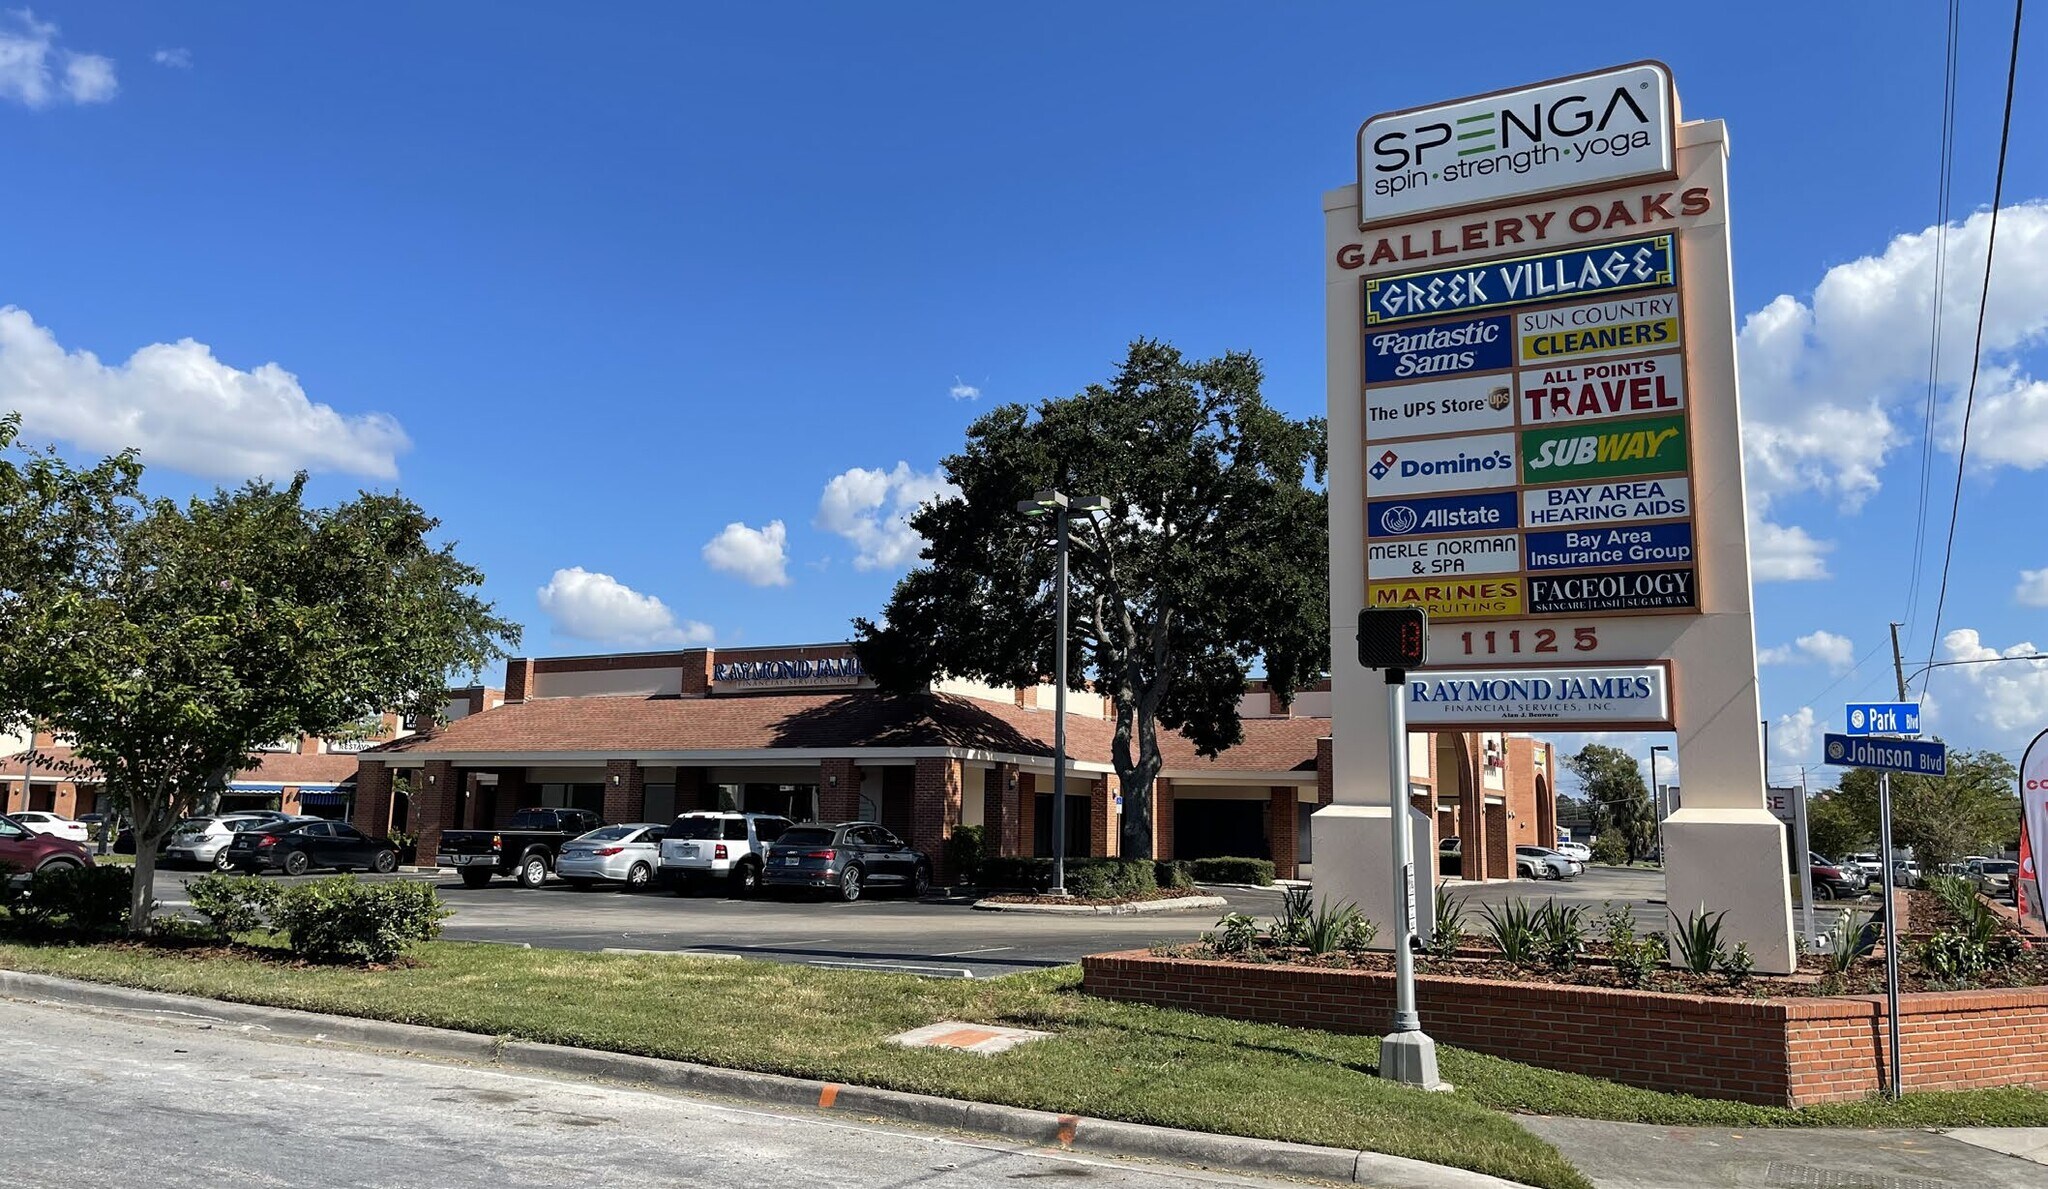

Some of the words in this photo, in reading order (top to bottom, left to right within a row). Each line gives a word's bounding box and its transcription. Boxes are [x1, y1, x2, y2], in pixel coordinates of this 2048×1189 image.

[1373, 86, 1650, 172] SPENGA
[1375, 167, 1428, 197] spin
[1443, 143, 1560, 182] strength
[1573, 130, 1651, 163] yoga
[1337, 211, 1556, 270] GALLERY
[1568, 187, 1711, 234] OAKS
[1379, 270, 1488, 316] GREEK
[1500, 247, 1654, 299] VILLAGE
[1524, 311, 1565, 332] SUN
[1572, 297, 1674, 326] COUNTRY
[1372, 320, 1500, 356] Fantastic
[1532, 321, 1668, 356] CLEANERS
[1394, 351, 1475, 377] Sams
[1543, 370, 1578, 385] ALL
[1583, 360, 1657, 380] POINTS
[1369, 406, 1398, 422] The
[1404, 400, 1436, 418] UPS
[1441, 398, 1484, 414] Store
[1489, 391, 1510, 410] ups
[1525, 375, 1678, 421] TRAVEL
[1529, 426, 1680, 470] SUBWAY
[1401, 450, 1512, 478] Domino's
[1547, 487, 1593, 506] BAY
[1599, 482, 1666, 502] AREA
[1420, 506, 1500, 528] Allstate
[1531, 503, 1627, 524] HEARING
[1633, 499, 1686, 517] AIDS
[1369, 542, 1428, 560] MERLE
[1437, 537, 1517, 556] NORMAN
[1566, 532, 1602, 550] Bay
[1607, 530, 1652, 545] Area
[1412, 560, 1426, 574] &
[1431, 558, 1465, 574] SPA
[1531, 549, 1623, 566] Insurance
[1629, 545, 1690, 562] Group
[1377, 582, 1518, 604] MARINES
[1532, 572, 1691, 602] FACEOLOGY
[1424, 601, 1507, 615] RUITING
[1536, 601, 1587, 612] SKINCARE
[1593, 598, 1620, 610] LASH
[1627, 596, 1662, 607] SUGAR
[1666, 595, 1689, 605] WAX
[1461, 626, 1599, 655] 11125
[713, 659, 813, 681] RAYMOND
[1411, 678, 1553, 702] RAYMOND
[1556, 675, 1652, 700] JAMES
[1444, 703, 1511, 713] FINANCIAL
[1588, 702, 1617, 711] INC.
[1869, 707, 1897, 731] Park
[1906, 713, 1919, 730] Blvd
[1846, 740, 1913, 768] Johnson
[1919, 753, 1942, 771] Blvd
